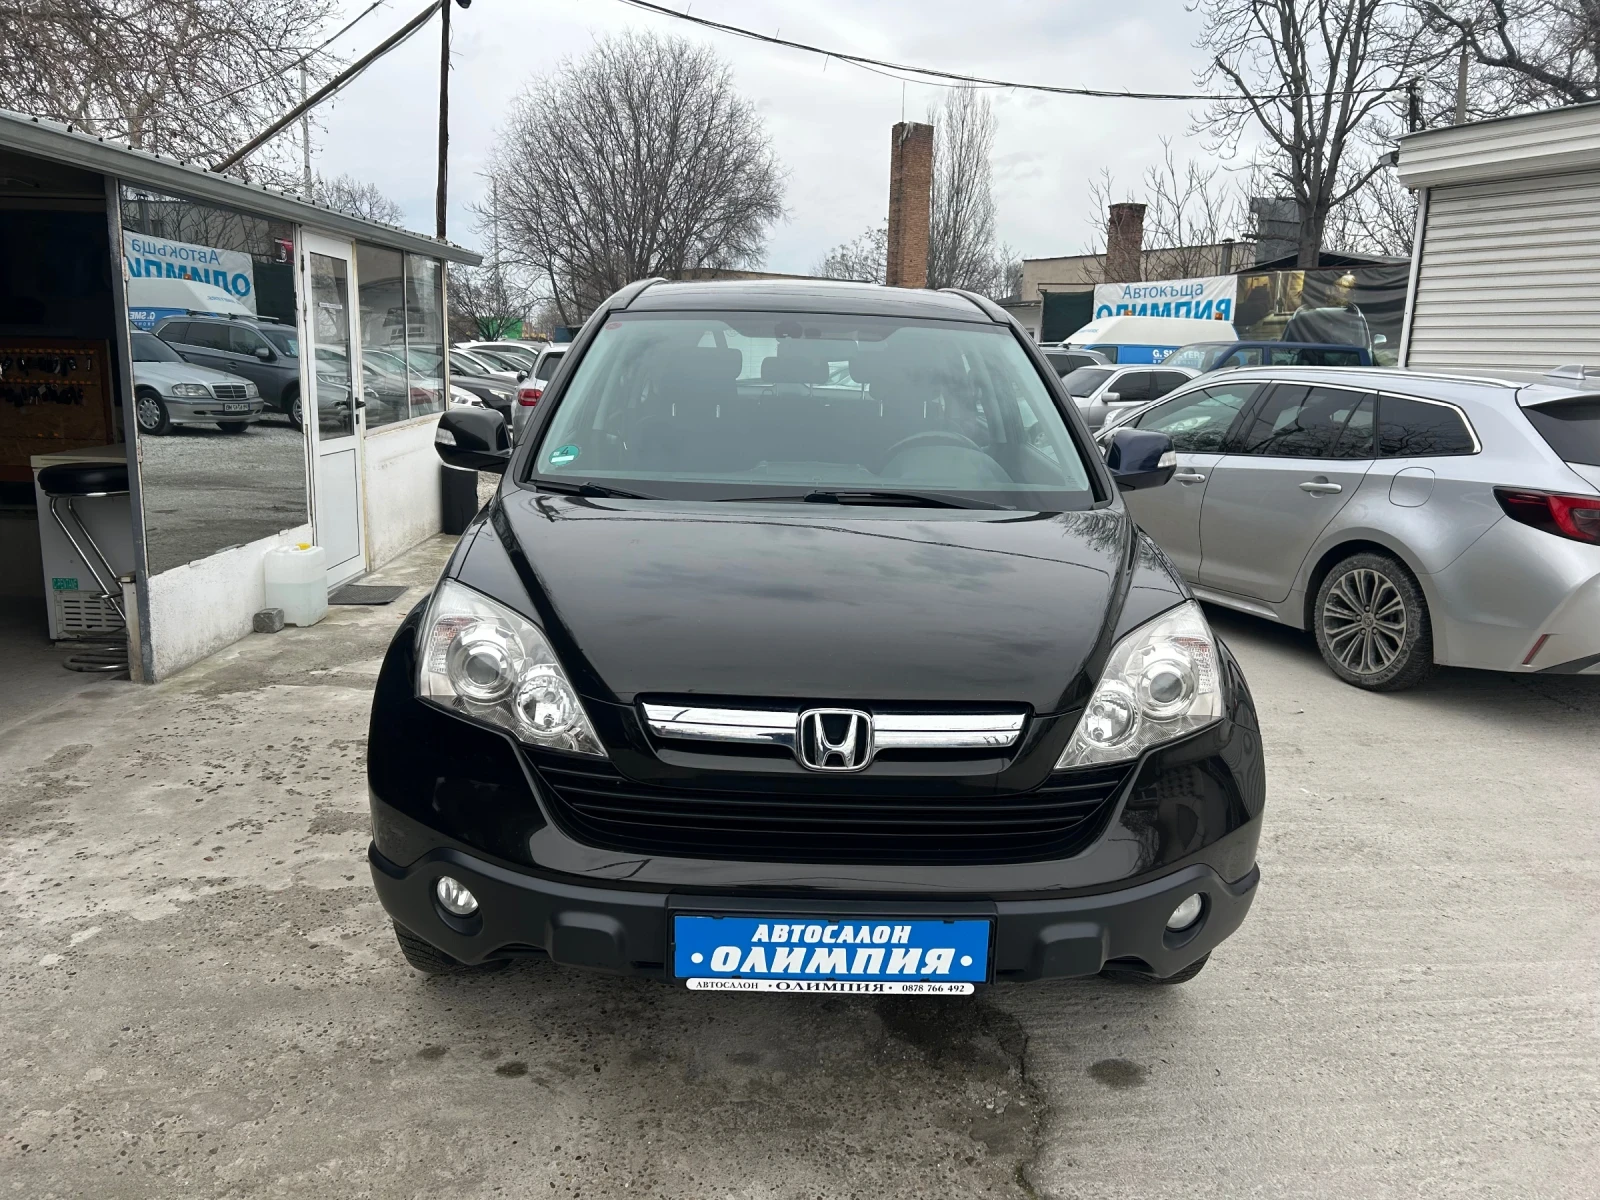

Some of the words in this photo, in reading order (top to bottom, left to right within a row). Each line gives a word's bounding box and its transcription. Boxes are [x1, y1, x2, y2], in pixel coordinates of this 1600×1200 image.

[1122, 283, 1204, 299] Автокъща
[1152, 349, 1163, 358] G.
[561, 446, 569, 456] 4
[751, 924, 912, 944] АВТОСАЛОН
[710, 946, 956, 974] ОЛИМПИЯ
[696, 981, 759, 990] АВТОСАЛОН
[776, 981, 885, 992] ОЛИМПИЯ
[902, 984, 924, 992] 0878
[927, 984, 944, 992] 766
[947, 985, 965, 993] 492
